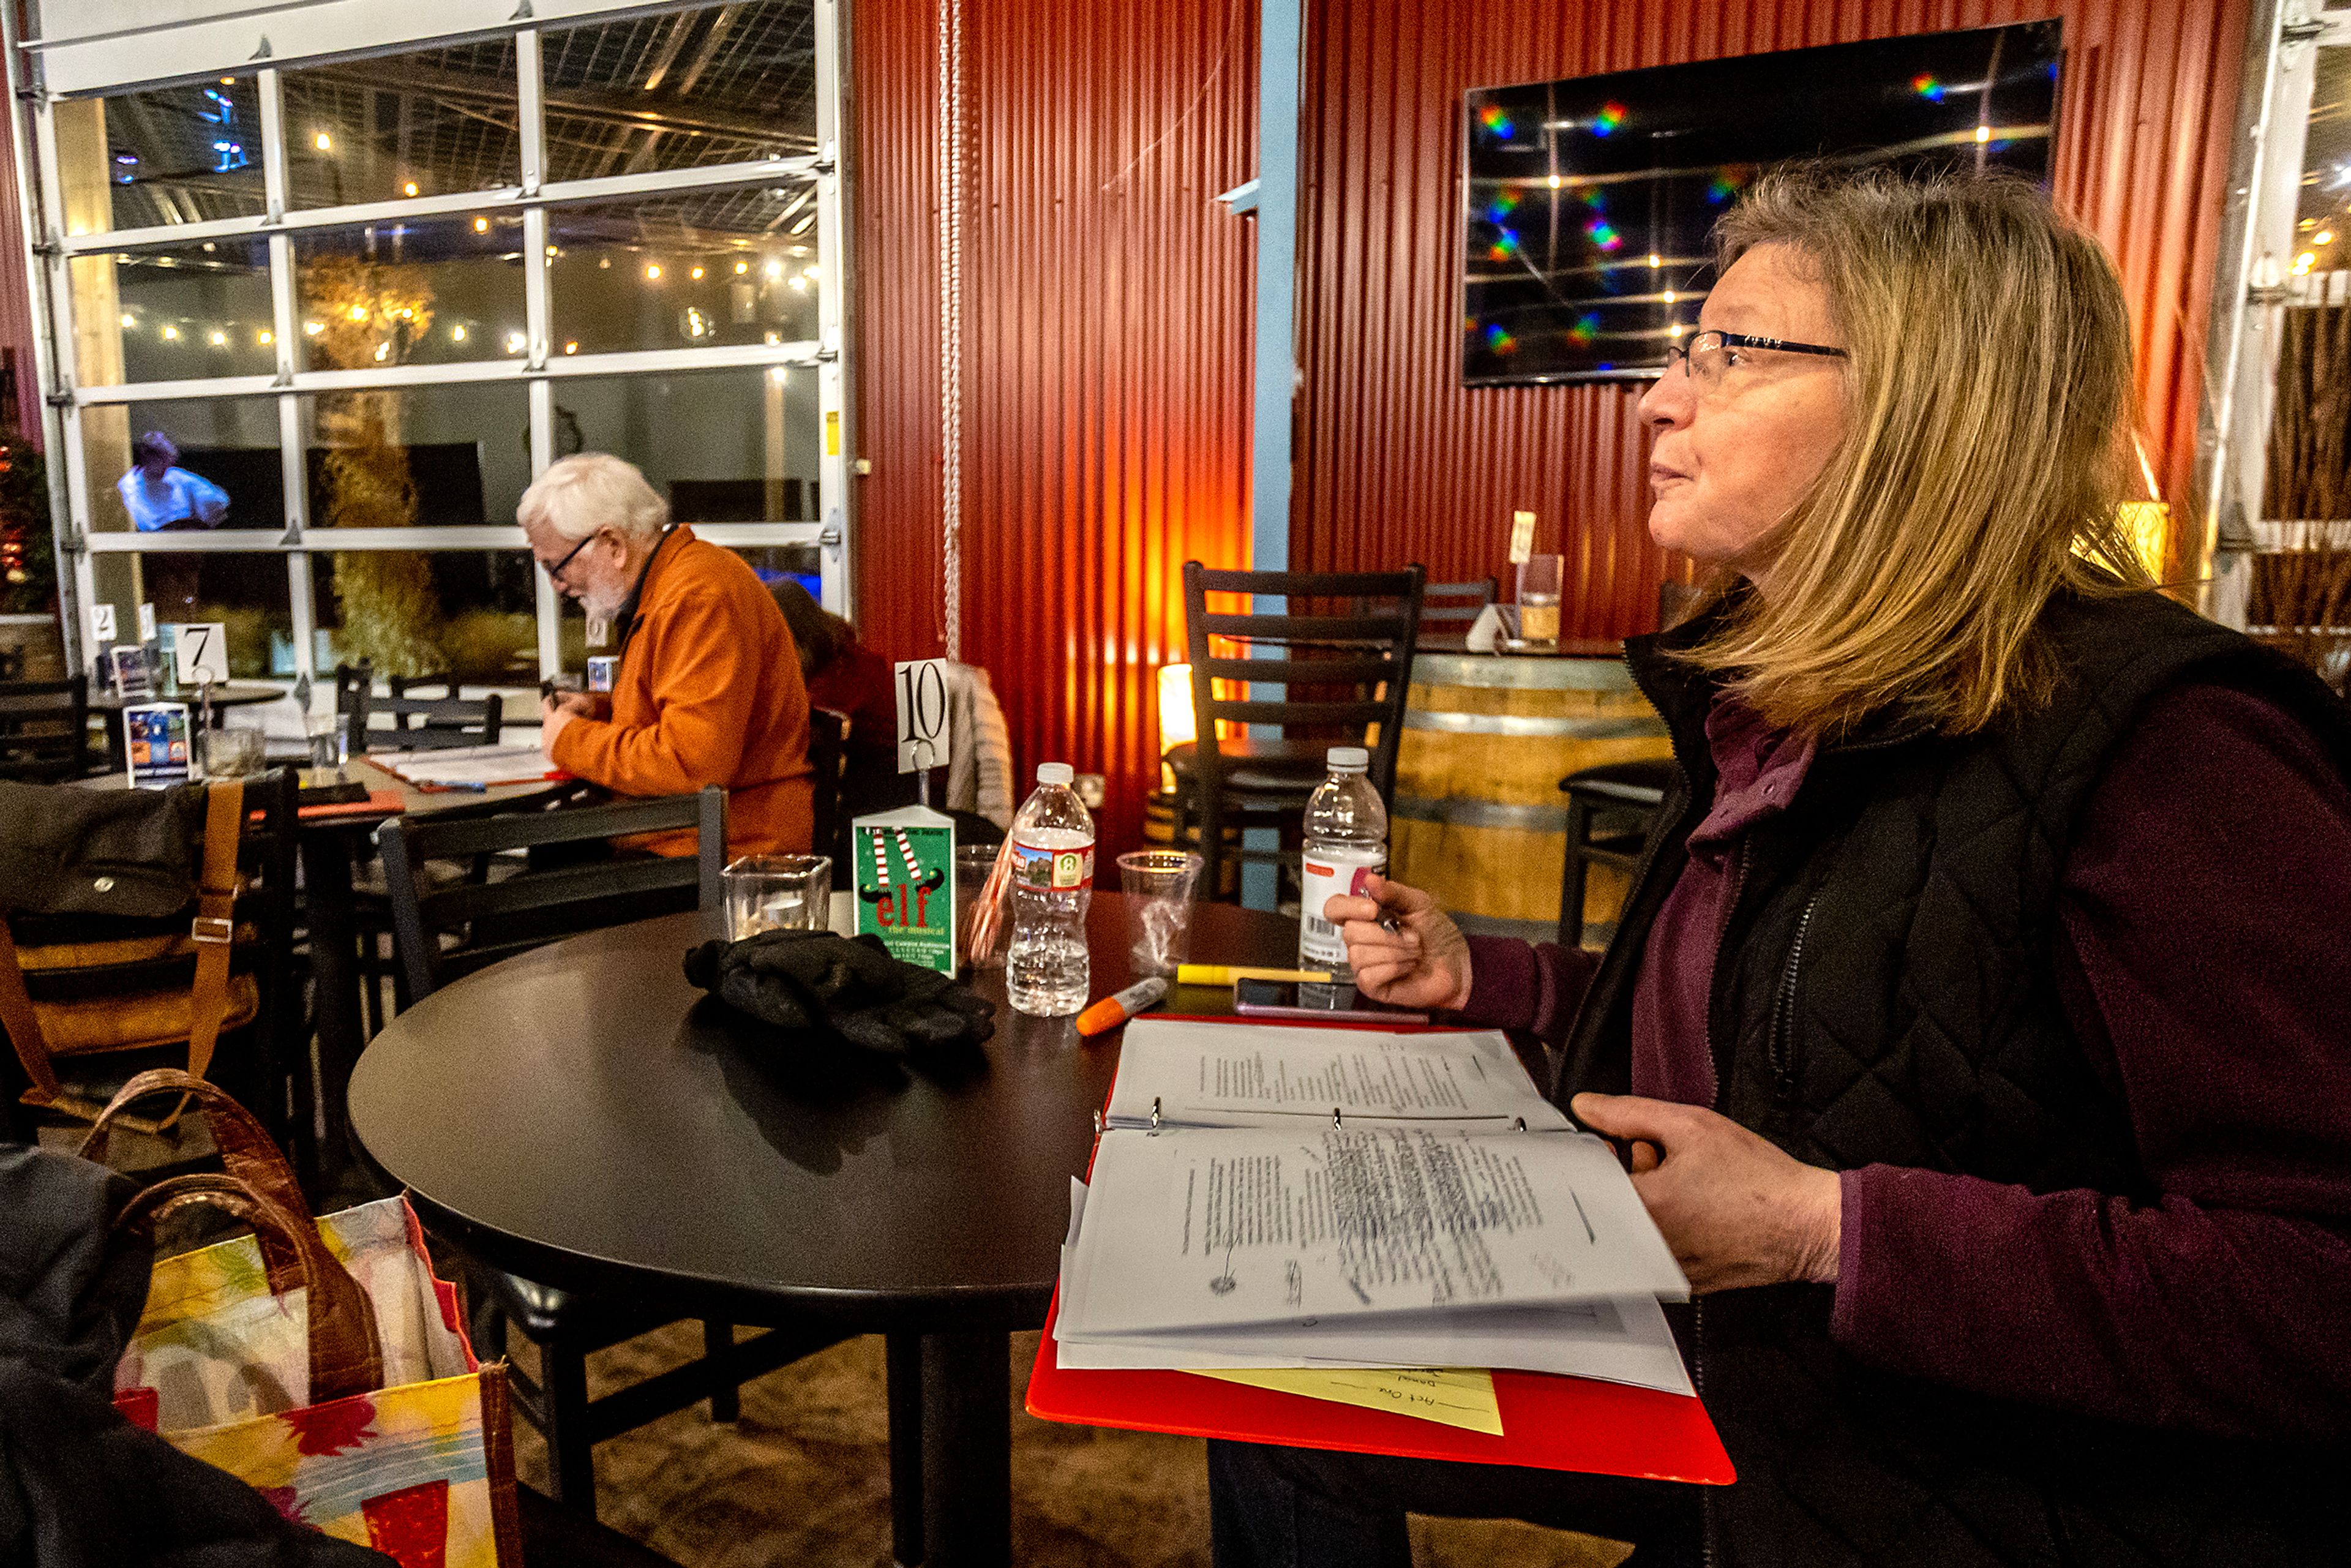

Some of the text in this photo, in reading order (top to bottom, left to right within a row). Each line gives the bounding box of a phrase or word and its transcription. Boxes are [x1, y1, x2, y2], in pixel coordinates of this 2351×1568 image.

[185, 627, 210, 666] 7
[898, 662, 945, 743] 10
[877, 883, 931, 928] elf
[889, 926, 904, 934] the
[1379, 1387, 1434, 1405] Act One
